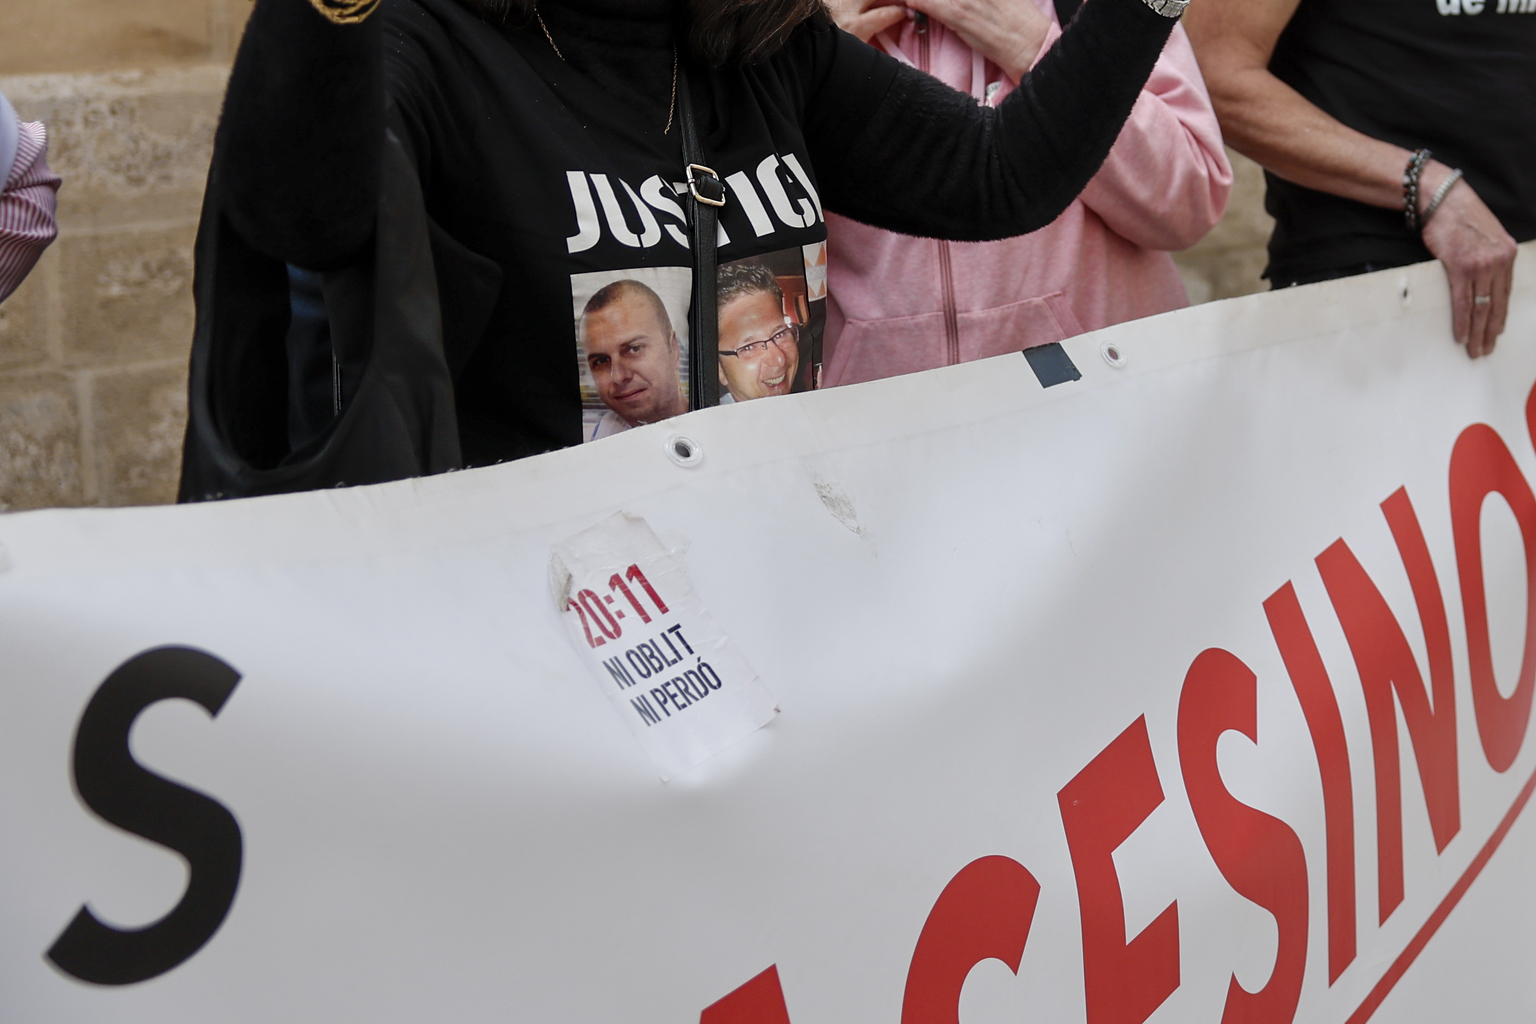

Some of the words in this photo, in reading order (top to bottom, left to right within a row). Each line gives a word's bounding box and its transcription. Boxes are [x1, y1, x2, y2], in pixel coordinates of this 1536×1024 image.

[566, 563, 670, 648] 20:11
[602, 656, 637, 691] NI
[625, 623, 695, 679] OBLIT
[629, 694, 663, 727] NI
[649, 656, 723, 718] PERDÓ
